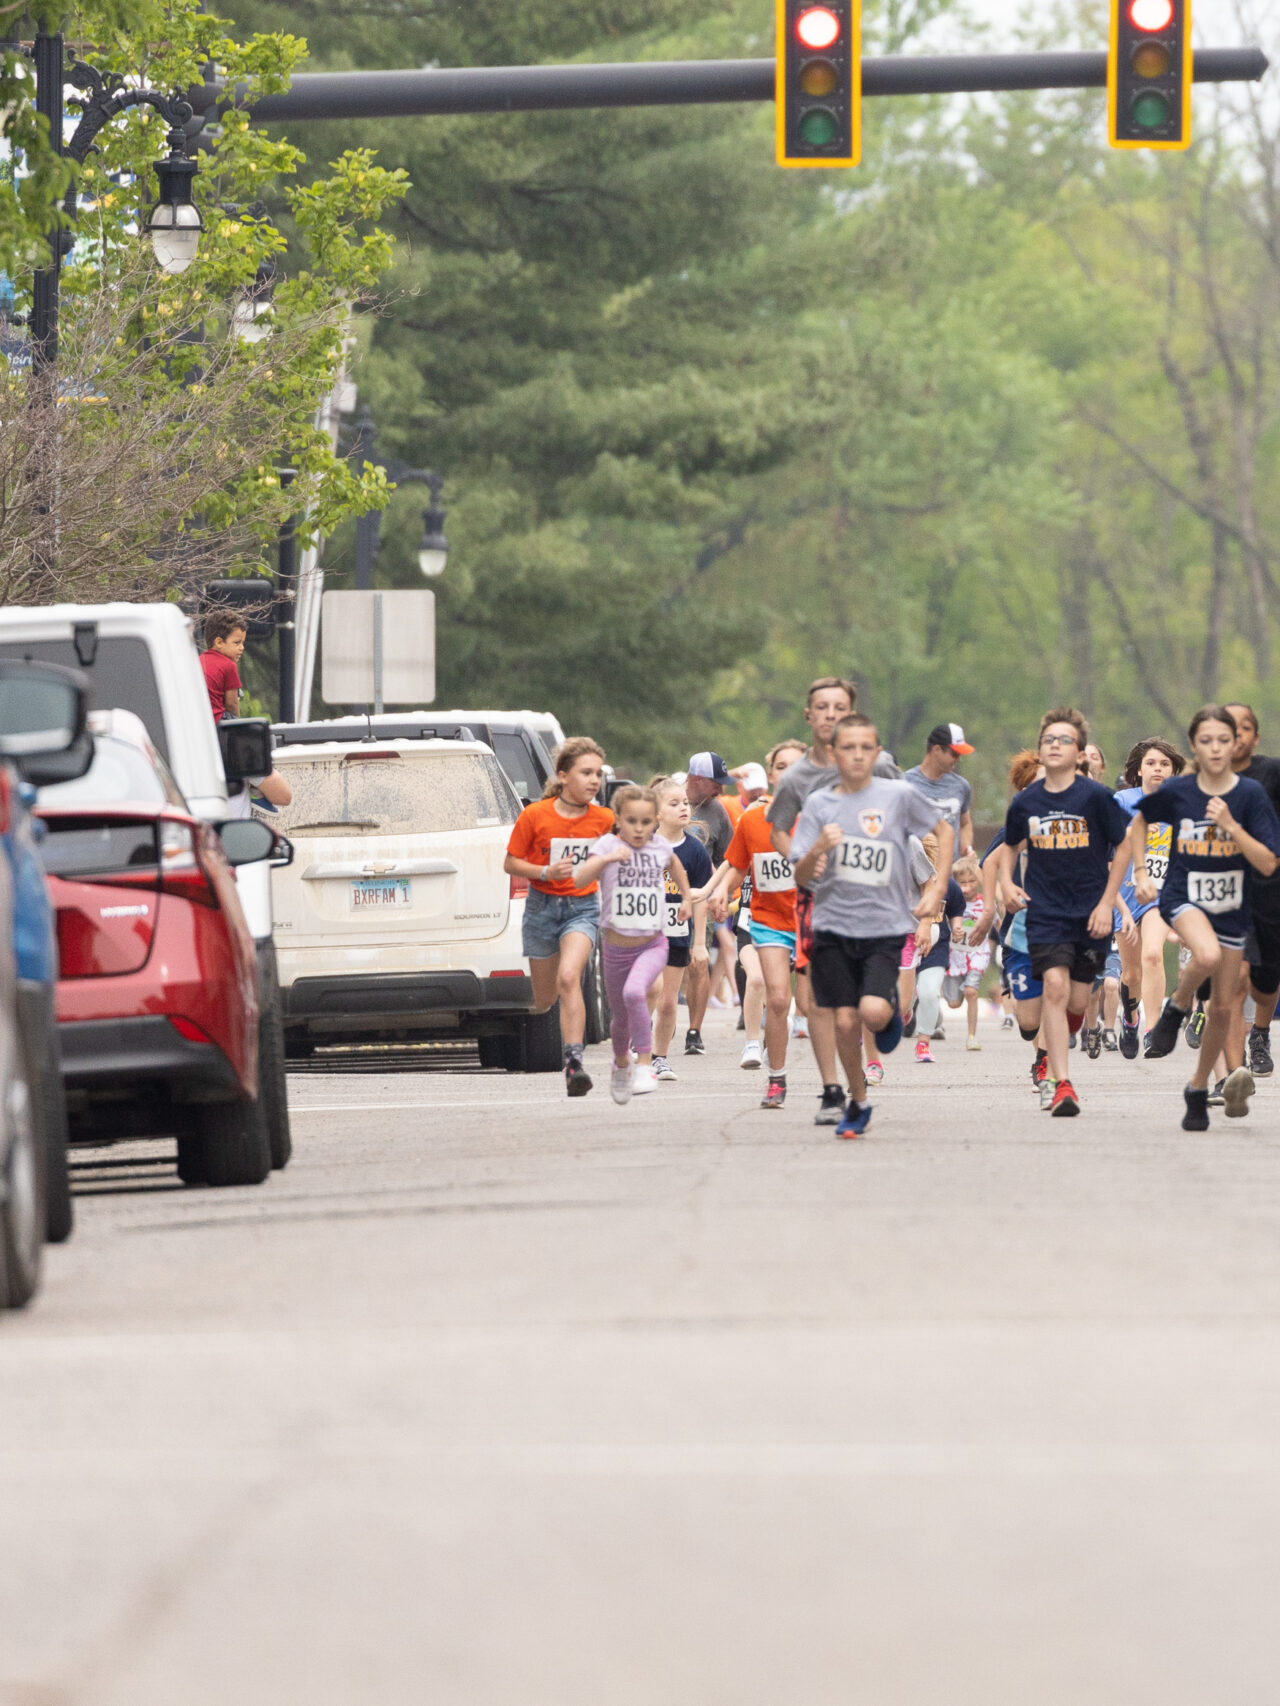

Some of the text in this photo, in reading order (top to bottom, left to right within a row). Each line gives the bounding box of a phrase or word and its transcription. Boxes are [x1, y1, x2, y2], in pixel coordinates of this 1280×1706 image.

[1056, 832, 1090, 849] RUN
[561, 845, 590, 866] 454
[840, 843, 888, 873] 1330
[762, 859, 792, 880] 468
[354, 887, 410, 906] BXRFAM 1
[1195, 876, 1236, 902] 1334
[616, 893, 658, 917] 1360
